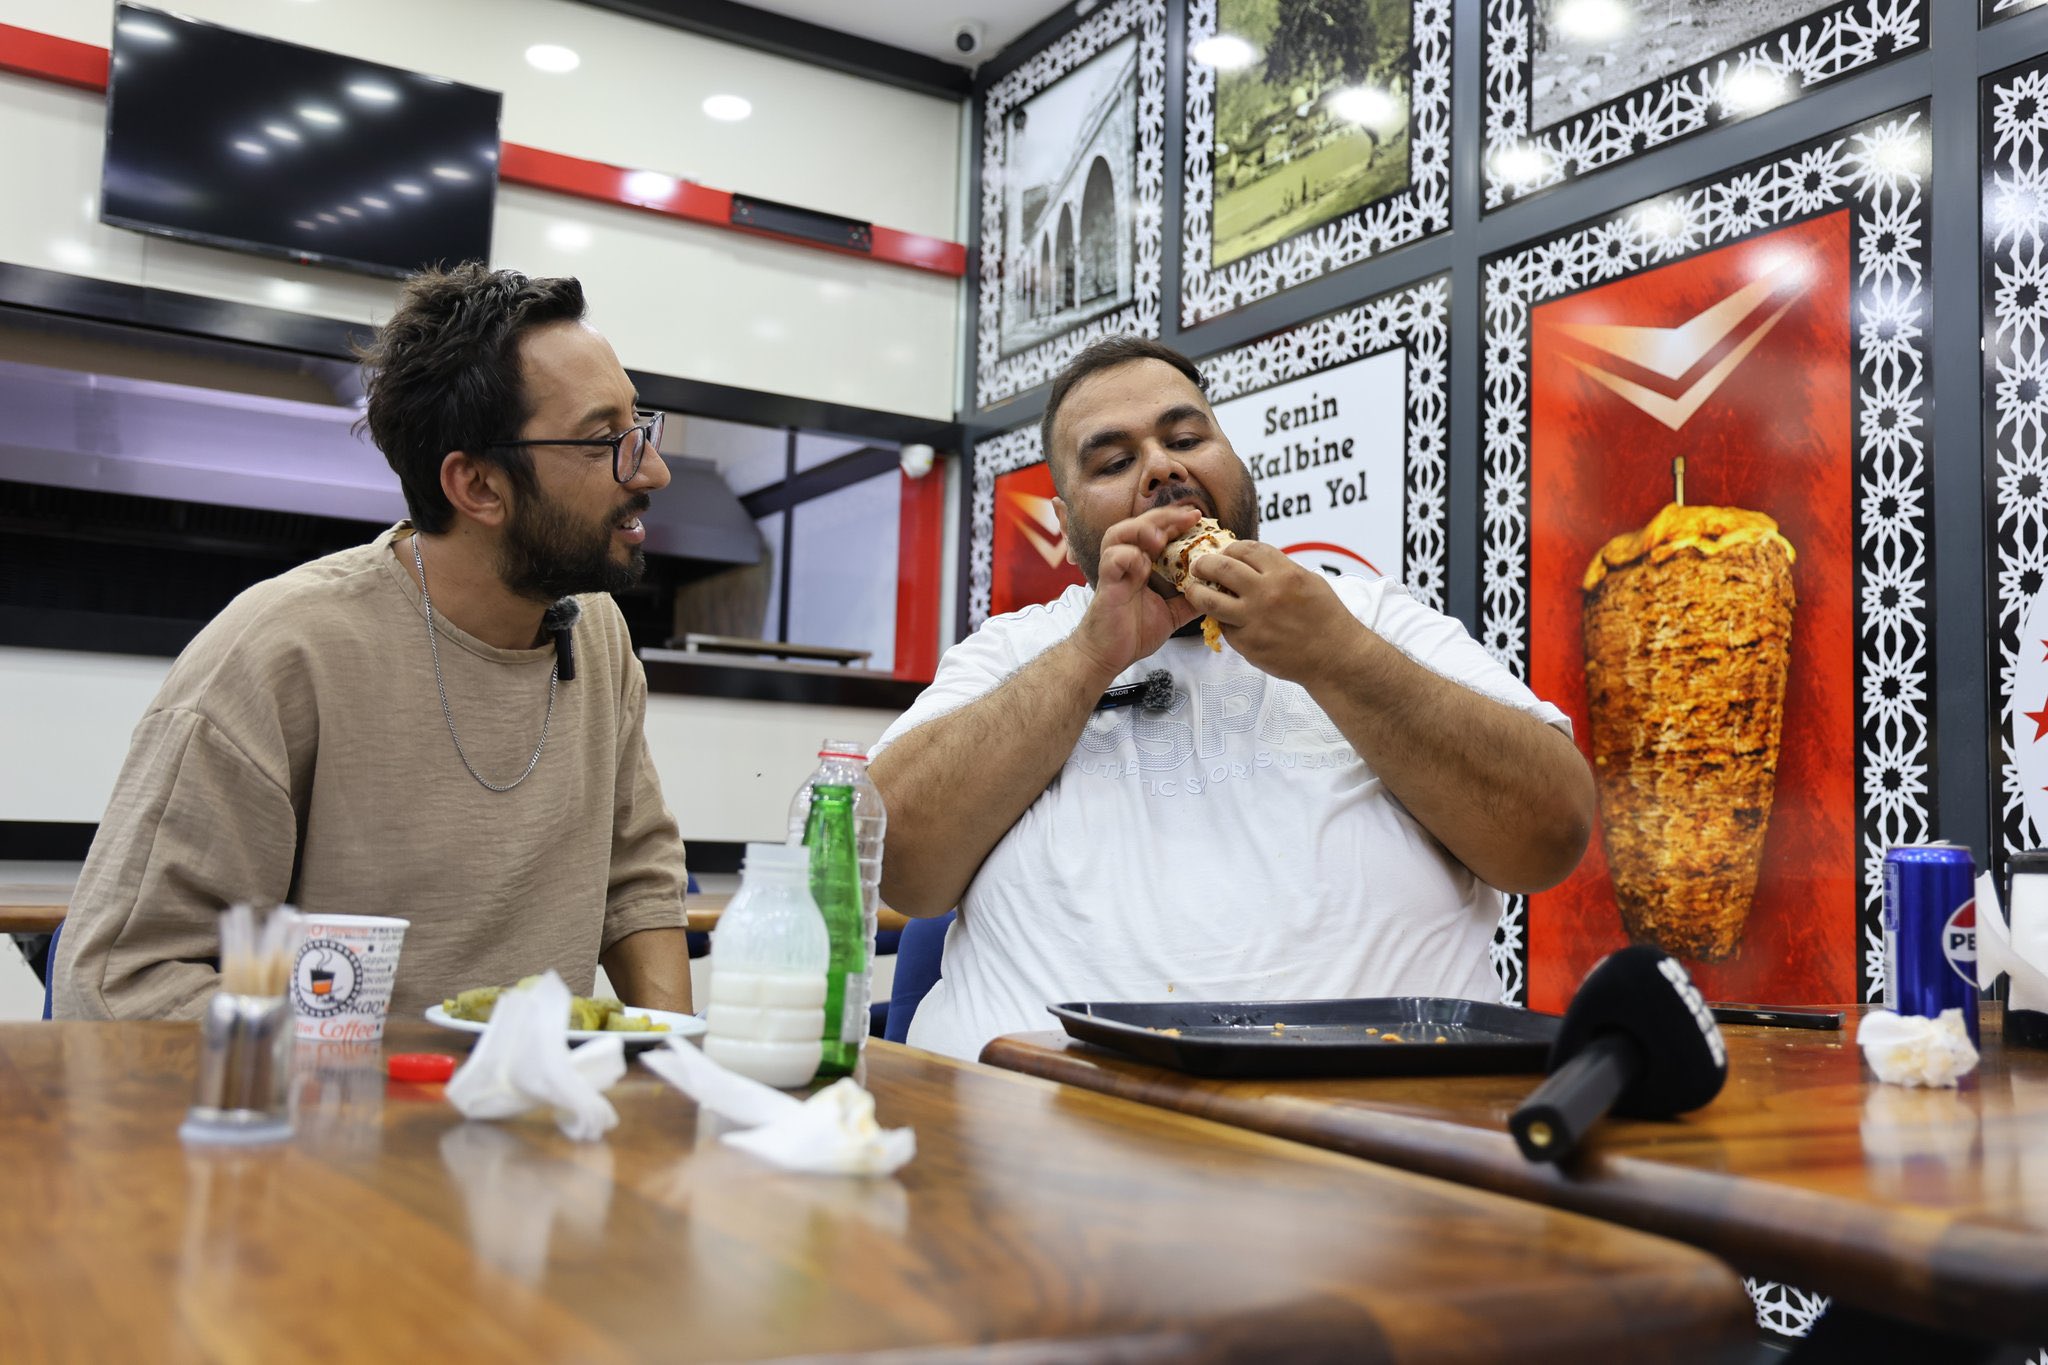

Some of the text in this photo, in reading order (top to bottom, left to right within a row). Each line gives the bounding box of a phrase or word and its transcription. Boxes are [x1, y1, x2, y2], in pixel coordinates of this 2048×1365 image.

[1265, 393, 1338, 435] Senin
[1250, 437, 1354, 482] Kalbine
[1258, 471, 1368, 523] iden Yol
[1109, 689, 1129, 697] BOYA
[1950, 933, 1976, 950] PE
[318, 1018, 377, 1042] Coffee
